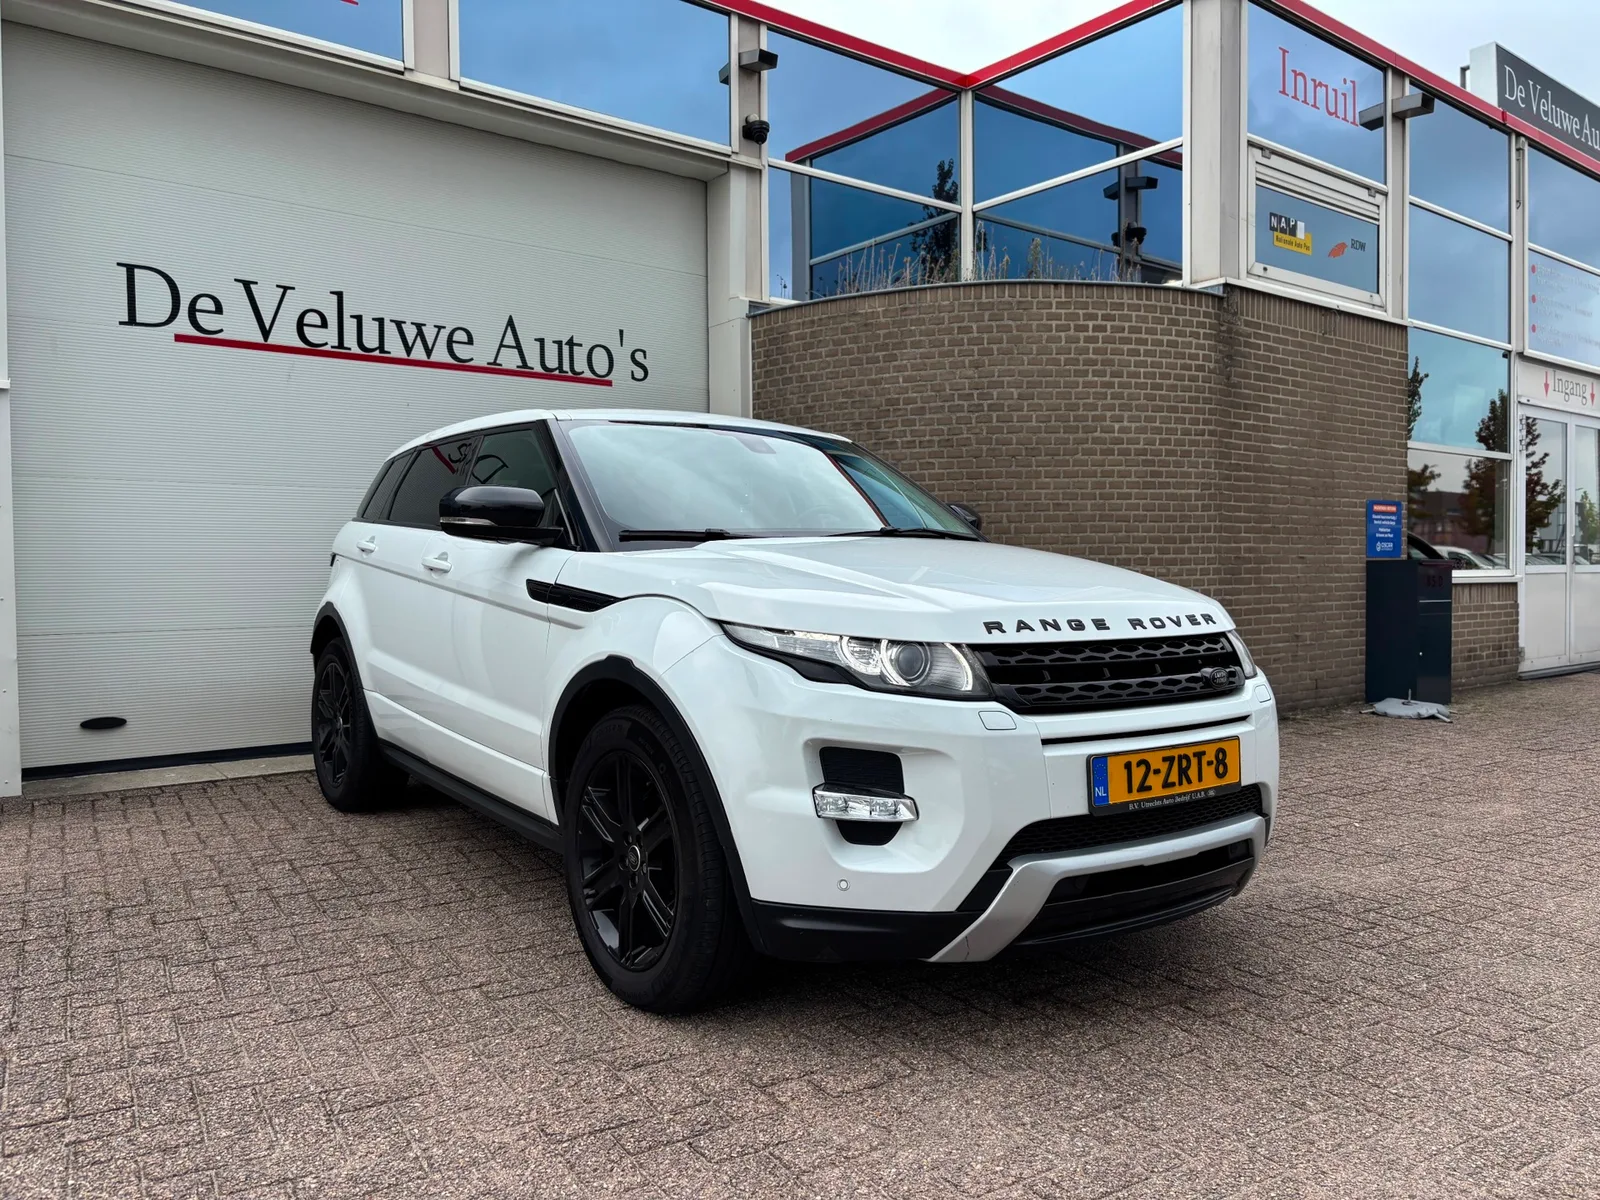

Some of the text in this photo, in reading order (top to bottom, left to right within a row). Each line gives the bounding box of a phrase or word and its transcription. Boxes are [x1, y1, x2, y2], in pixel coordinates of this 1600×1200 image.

[1278, 46, 1359, 127] Inruil
[1503, 64, 1526, 108] De
[1527, 79, 1580, 139] Veluwe
[1270, 215, 1297, 229] NAP
[1294, 240, 1303, 249] Auto
[1350, 238, 1367, 252] RDW
[116, 262, 649, 381] De Veluwe Auto's
[1552, 370, 1588, 406] Ingang
[982, 613, 1217, 635] RANGE ROVER
[1123, 747, 1229, 794] 12-ZRT-8
[1095, 786, 1107, 797] NL
[1140, 799, 1162, 808] Utrechts
[1175, 794, 1191, 803] Bedrijf
